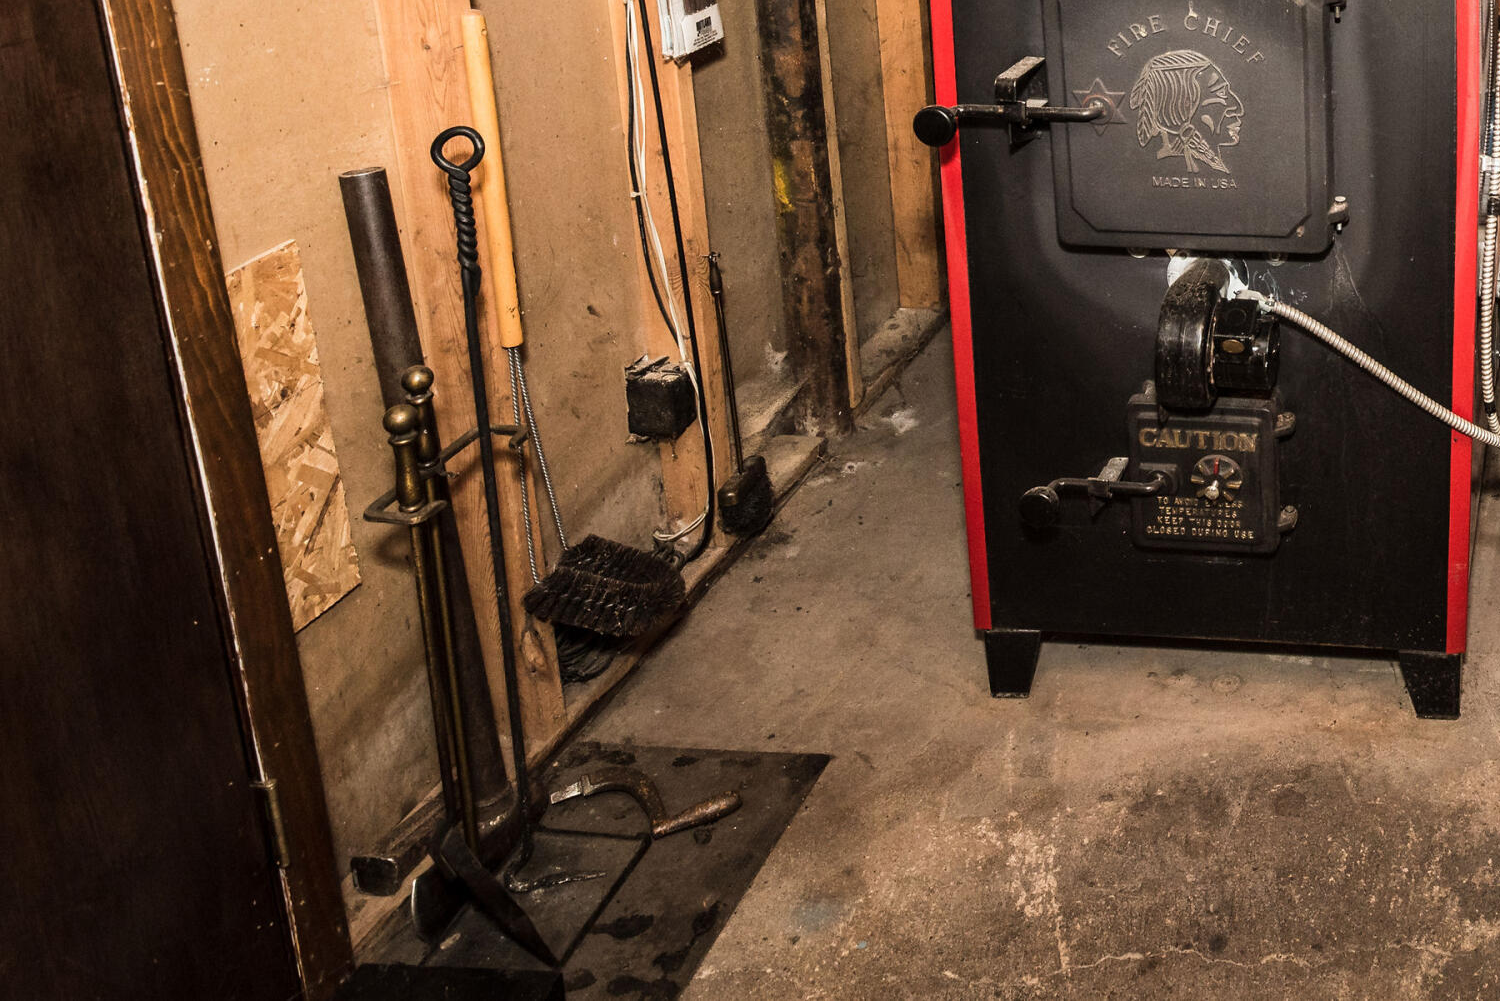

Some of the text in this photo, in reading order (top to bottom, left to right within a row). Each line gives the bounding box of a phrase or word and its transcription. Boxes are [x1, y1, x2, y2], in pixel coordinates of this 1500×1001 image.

[1106, 13, 1266, 64] FIRE CHIEF
[1151, 175, 1238, 190] MADE IN USA
[1138, 427, 1258, 453] CAUTION
[1156, 496, 1169, 505] TO
[1157, 515, 1184, 525] KEEP
[1188, 517, 1212, 528] THIS
[1146, 526, 1186, 536] CLOSED
[1233, 529, 1255, 540] USE
